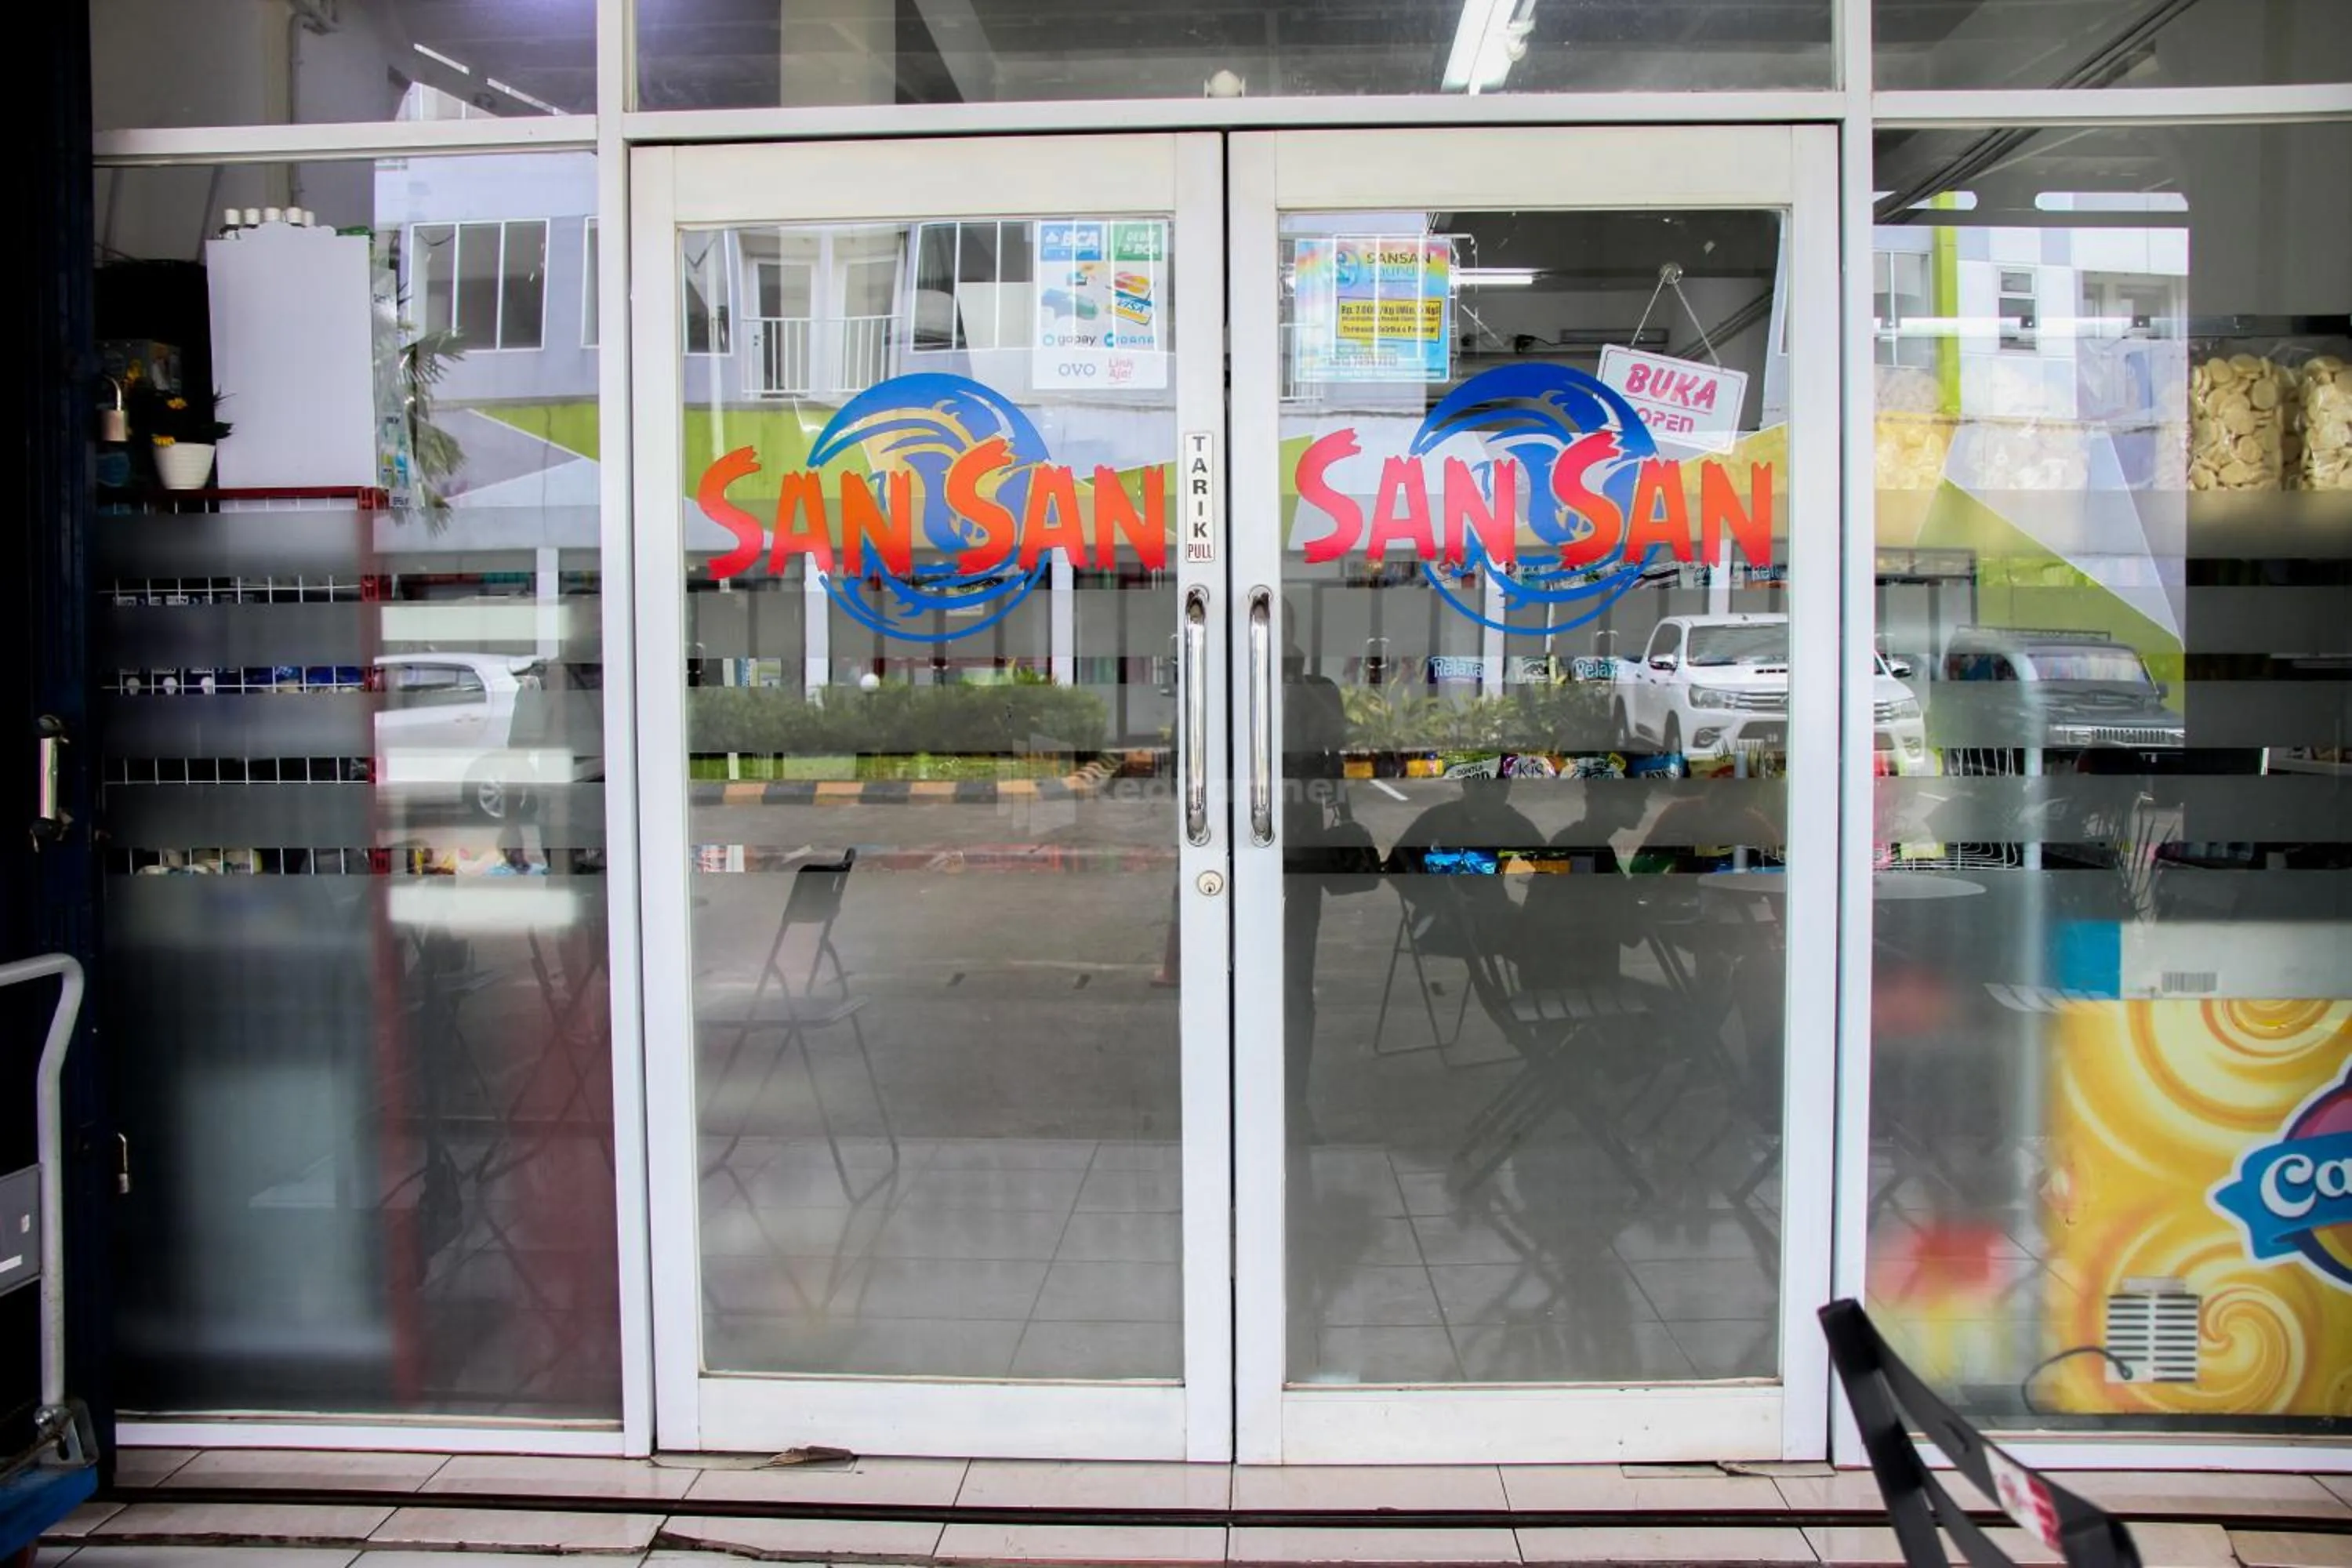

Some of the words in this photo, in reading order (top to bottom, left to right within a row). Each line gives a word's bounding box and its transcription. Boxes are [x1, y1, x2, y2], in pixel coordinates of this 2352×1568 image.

[1058, 363, 1096, 377] OVO
[1625, 363, 1718, 410] BUKA
[1636, 407, 1694, 434] OPEN
[1192, 436, 1208, 539] TARIK
[1188, 543, 1213, 559] PULL
